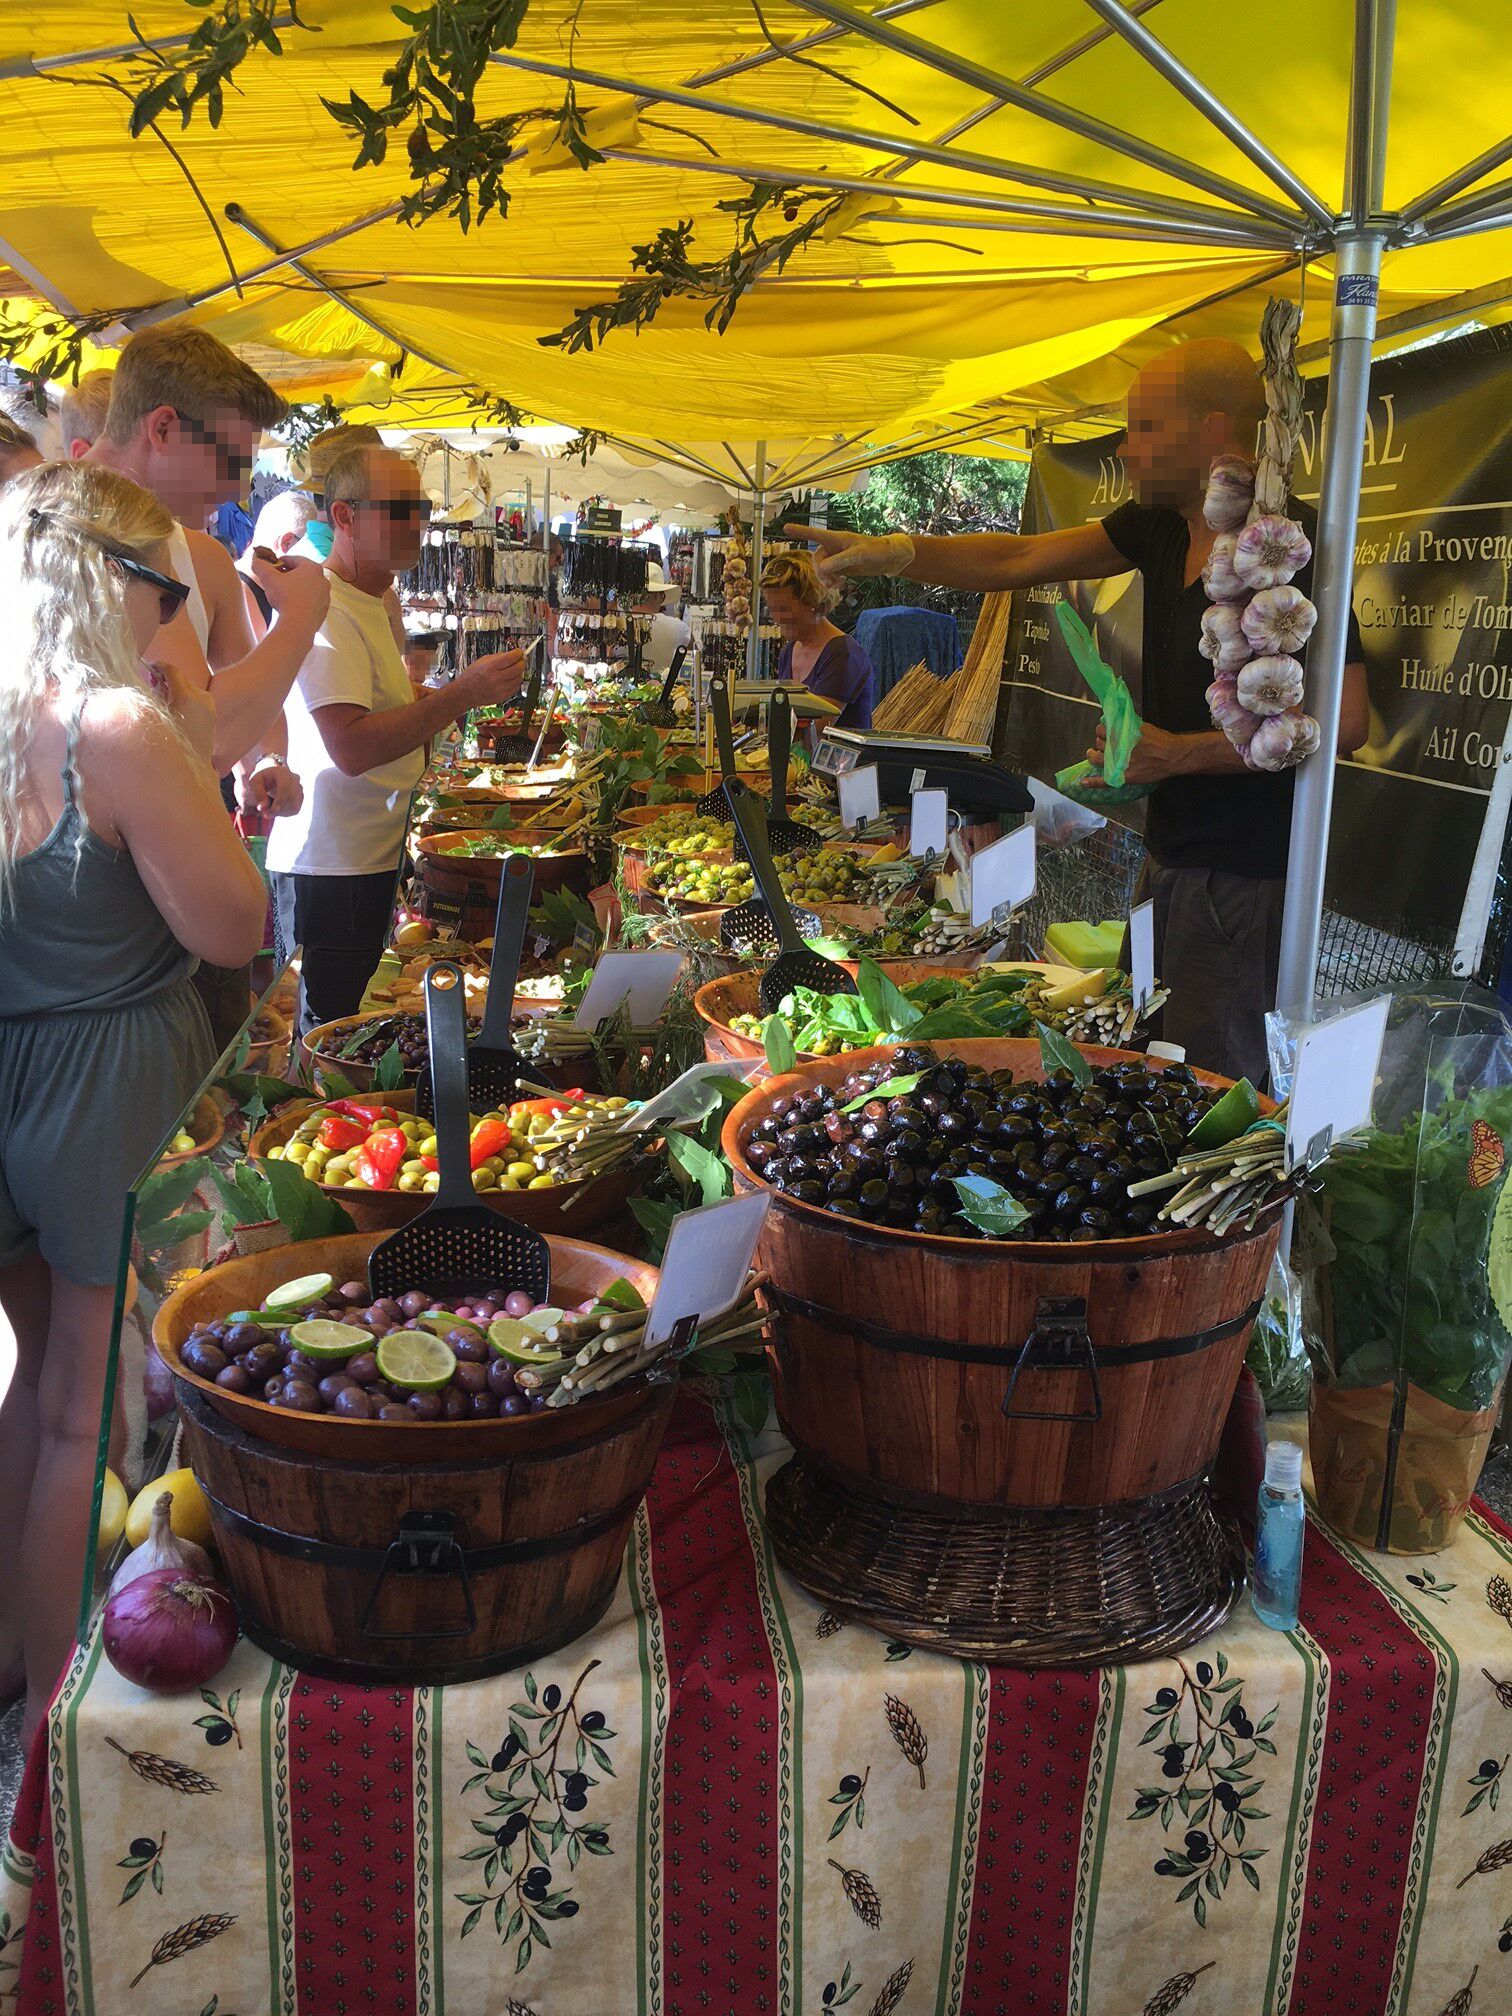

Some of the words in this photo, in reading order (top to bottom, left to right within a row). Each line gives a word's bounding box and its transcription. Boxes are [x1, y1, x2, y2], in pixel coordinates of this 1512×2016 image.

[1090, 455, 1125, 505] AU
[1379, 532, 1393, 564] à
[1392, 531, 1411, 564] la
[1360, 595, 1435, 628] Caviar
[1442, 594, 1468, 630] de
[1400, 658, 1454, 695] Huile
[1424, 726, 1458, 761] Ail
